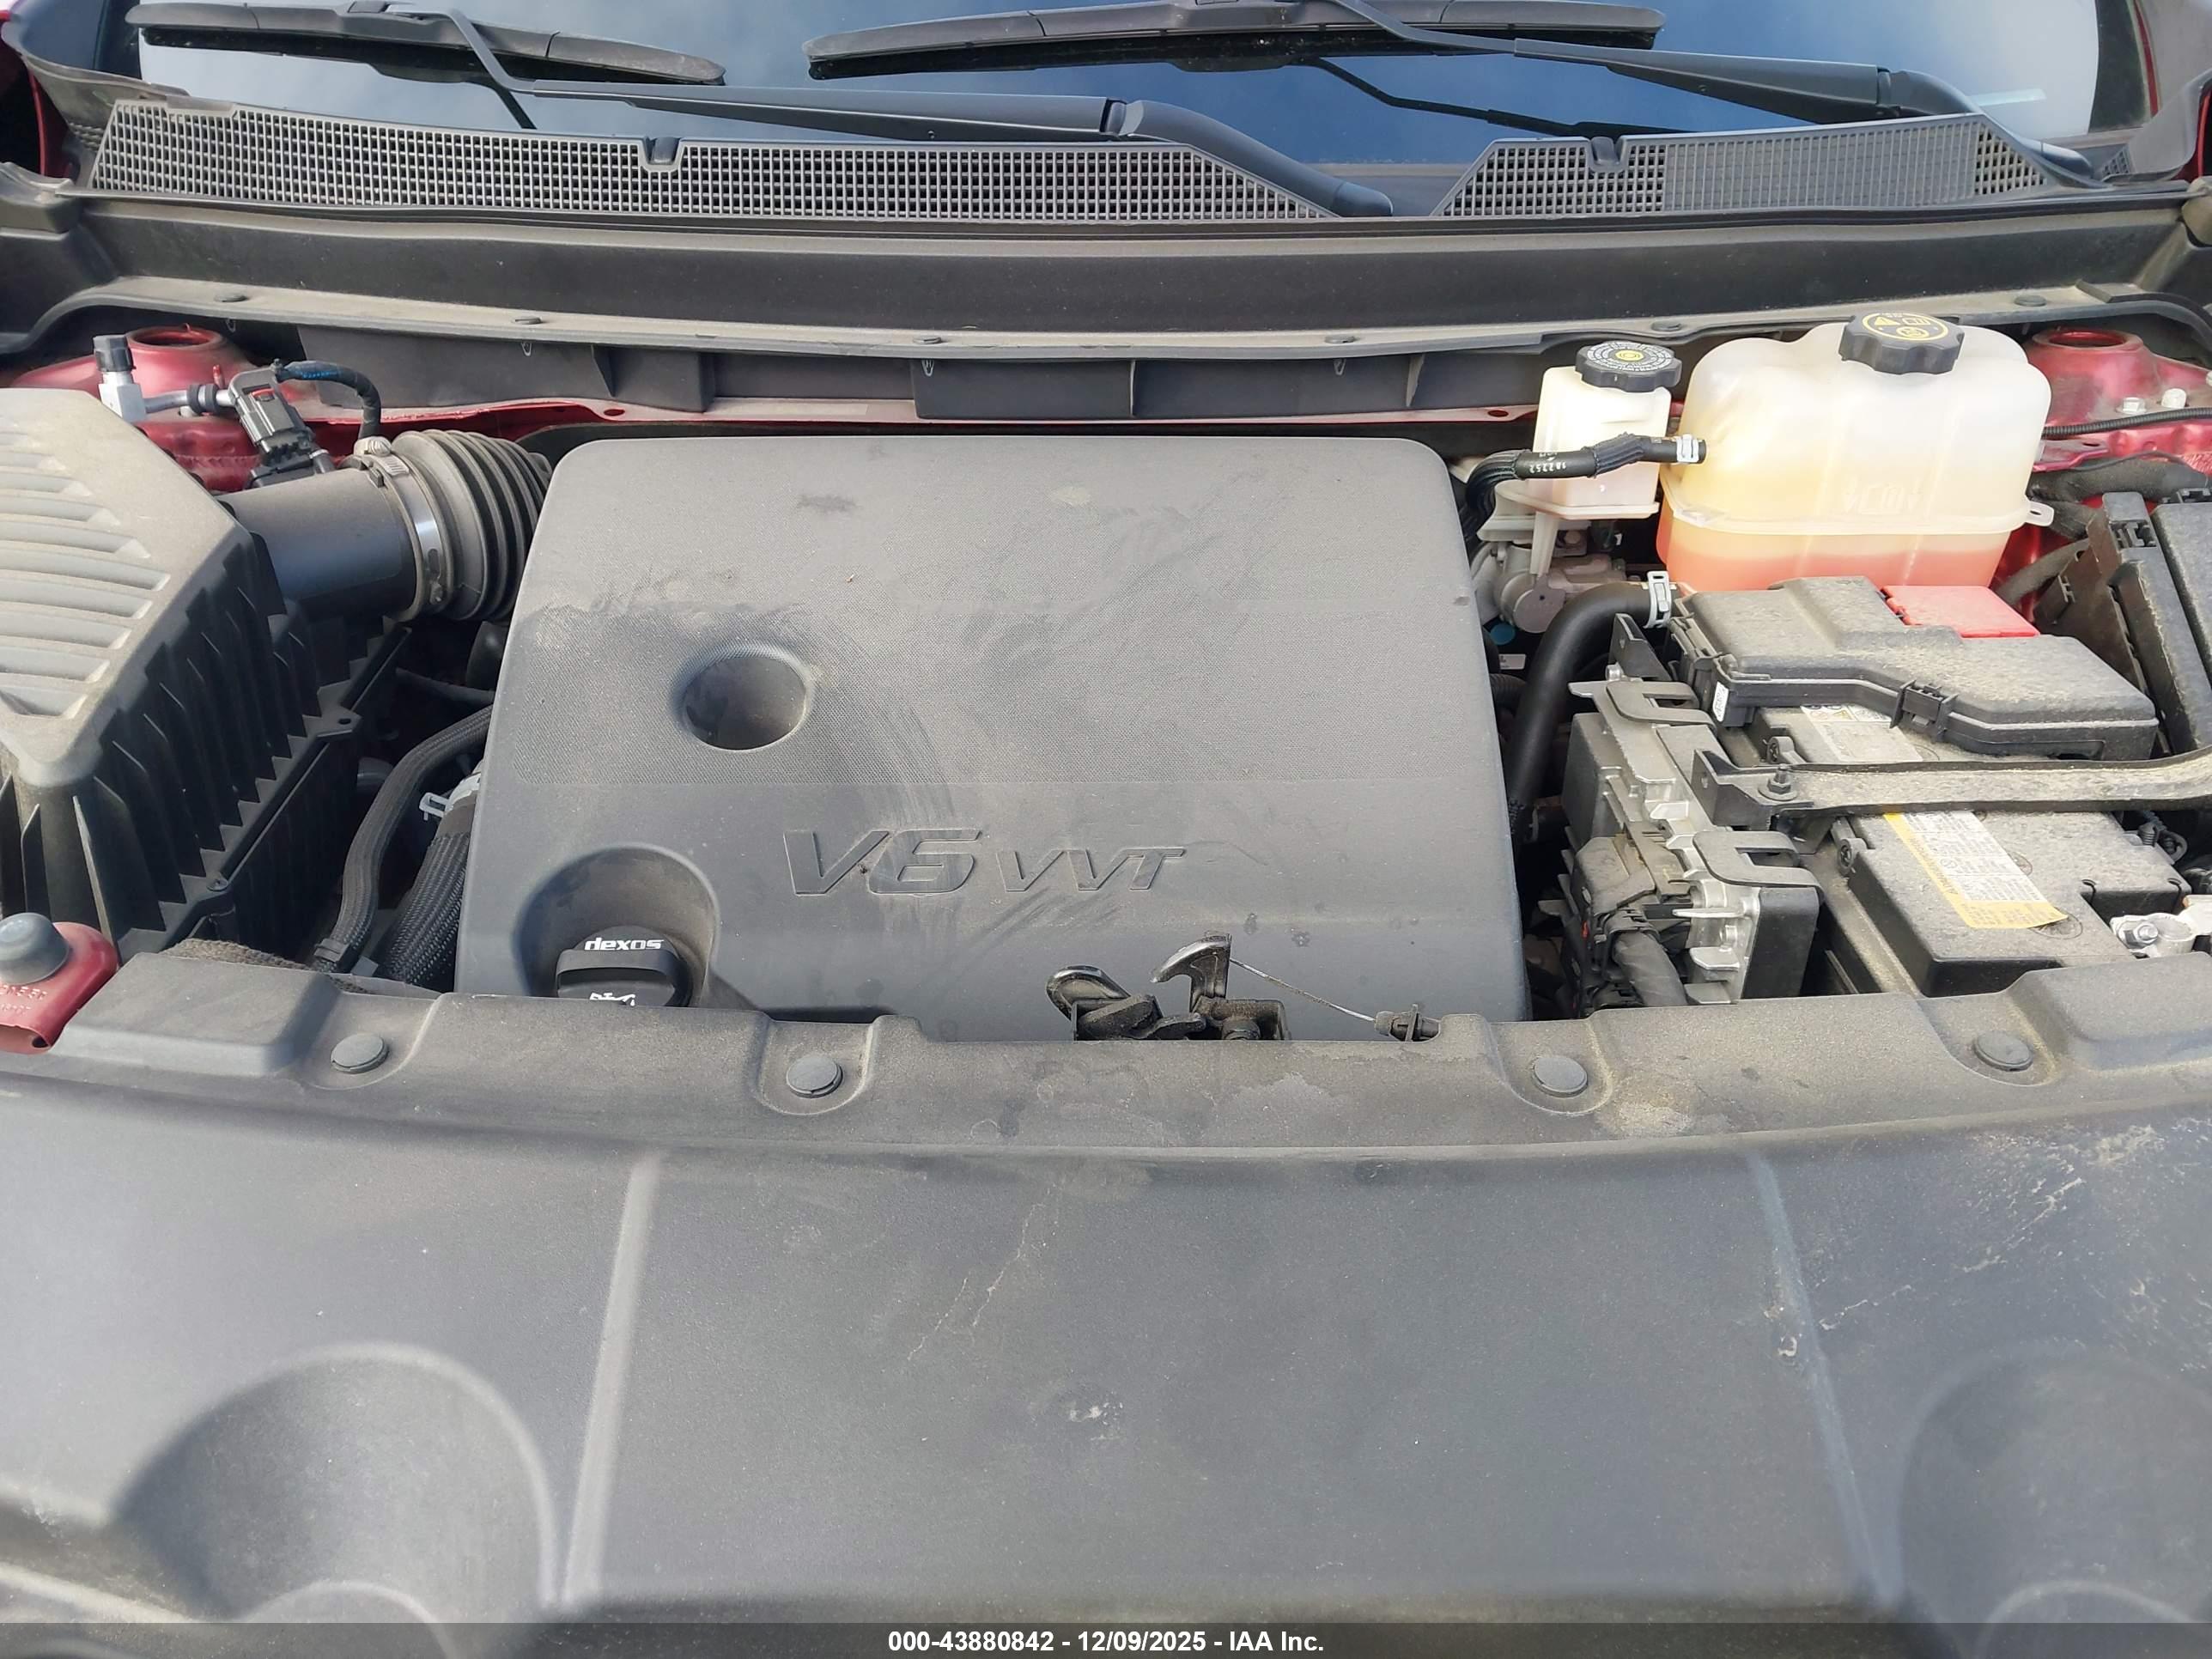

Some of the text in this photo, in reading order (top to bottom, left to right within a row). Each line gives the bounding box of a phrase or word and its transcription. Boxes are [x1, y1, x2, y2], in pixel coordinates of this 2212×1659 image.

[783, 829, 1186, 896] V6 VVT
[584, 937, 665, 951] dexos
